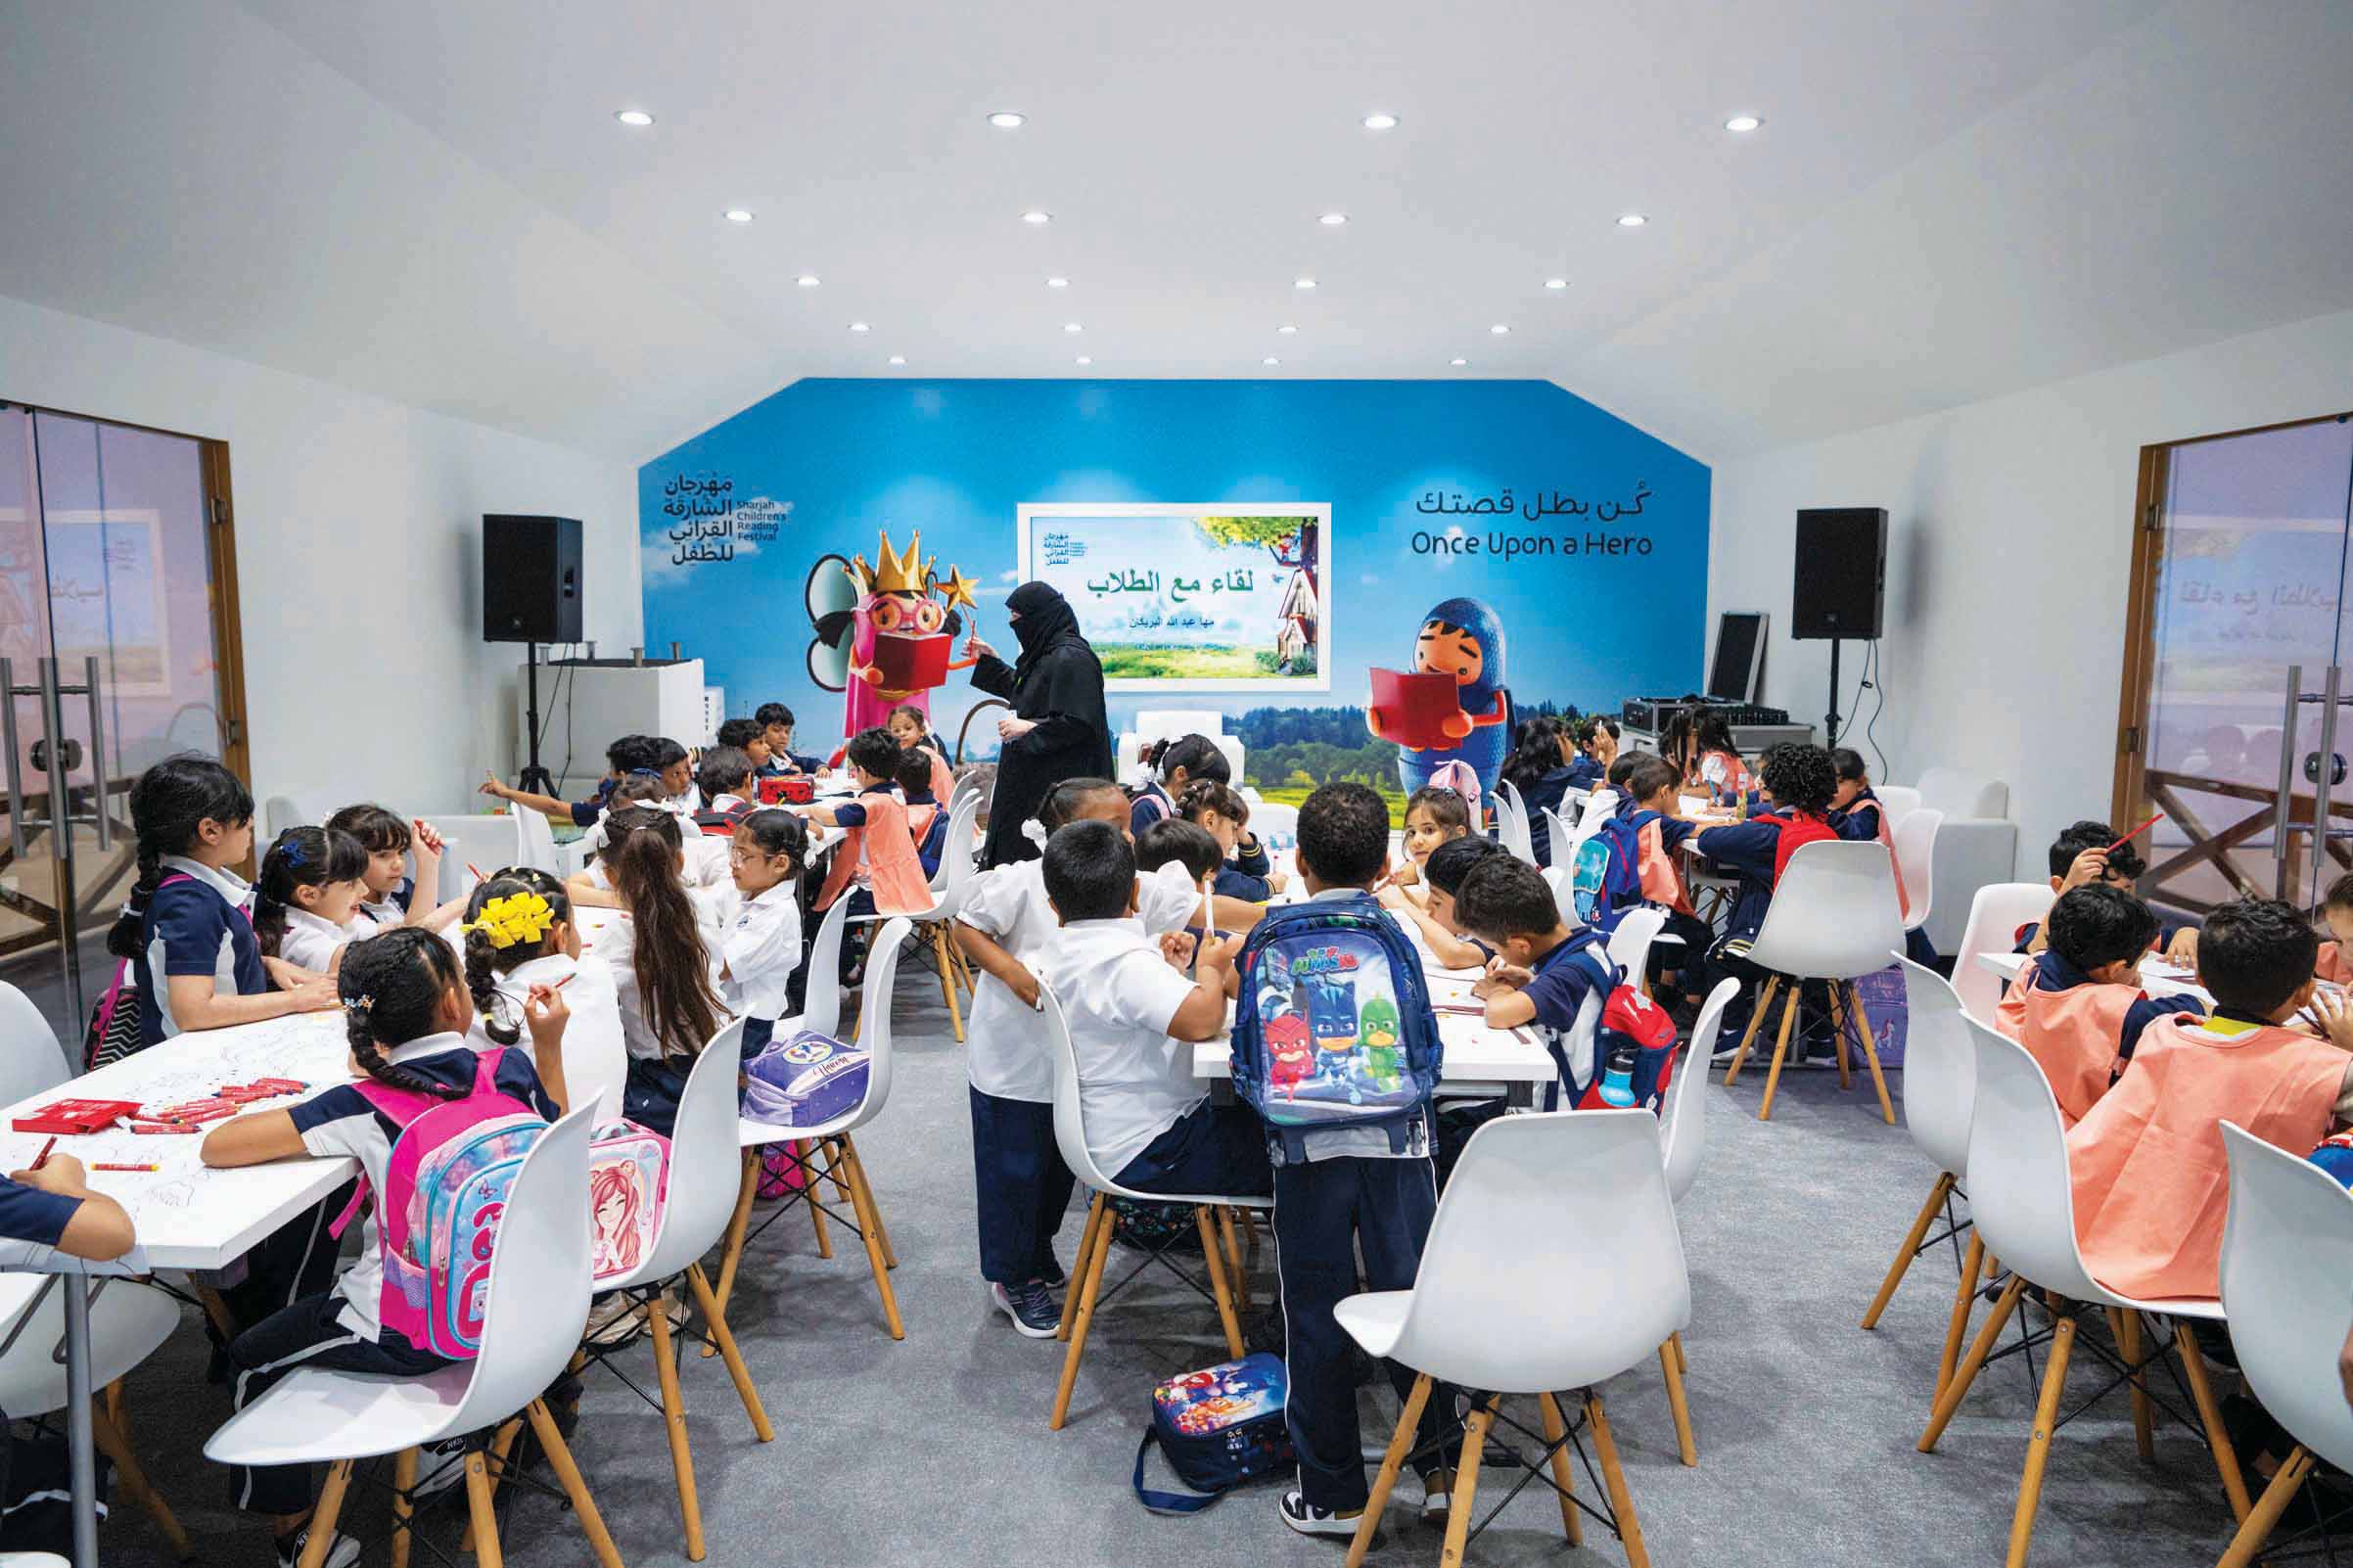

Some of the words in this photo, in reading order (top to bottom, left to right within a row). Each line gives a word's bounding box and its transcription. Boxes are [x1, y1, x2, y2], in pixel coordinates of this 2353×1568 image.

[736, 500, 775, 512] Sharjah
[1416, 488, 1515, 515] قصتك
[1523, 491, 1589, 522] بطل
[736, 511, 787, 522] Children's
[737, 521, 780, 532] Reading
[737, 531, 777, 541] Festival
[1411, 530, 1480, 555] Once
[1488, 531, 1554, 562] Upon
[1563, 537, 1578, 555] a
[1586, 531, 1653, 556] Hero
[1086, 568, 1160, 599] الطلاب
[1171, 576, 1201, 603] مع
[1212, 568, 1254, 593] لقاء
